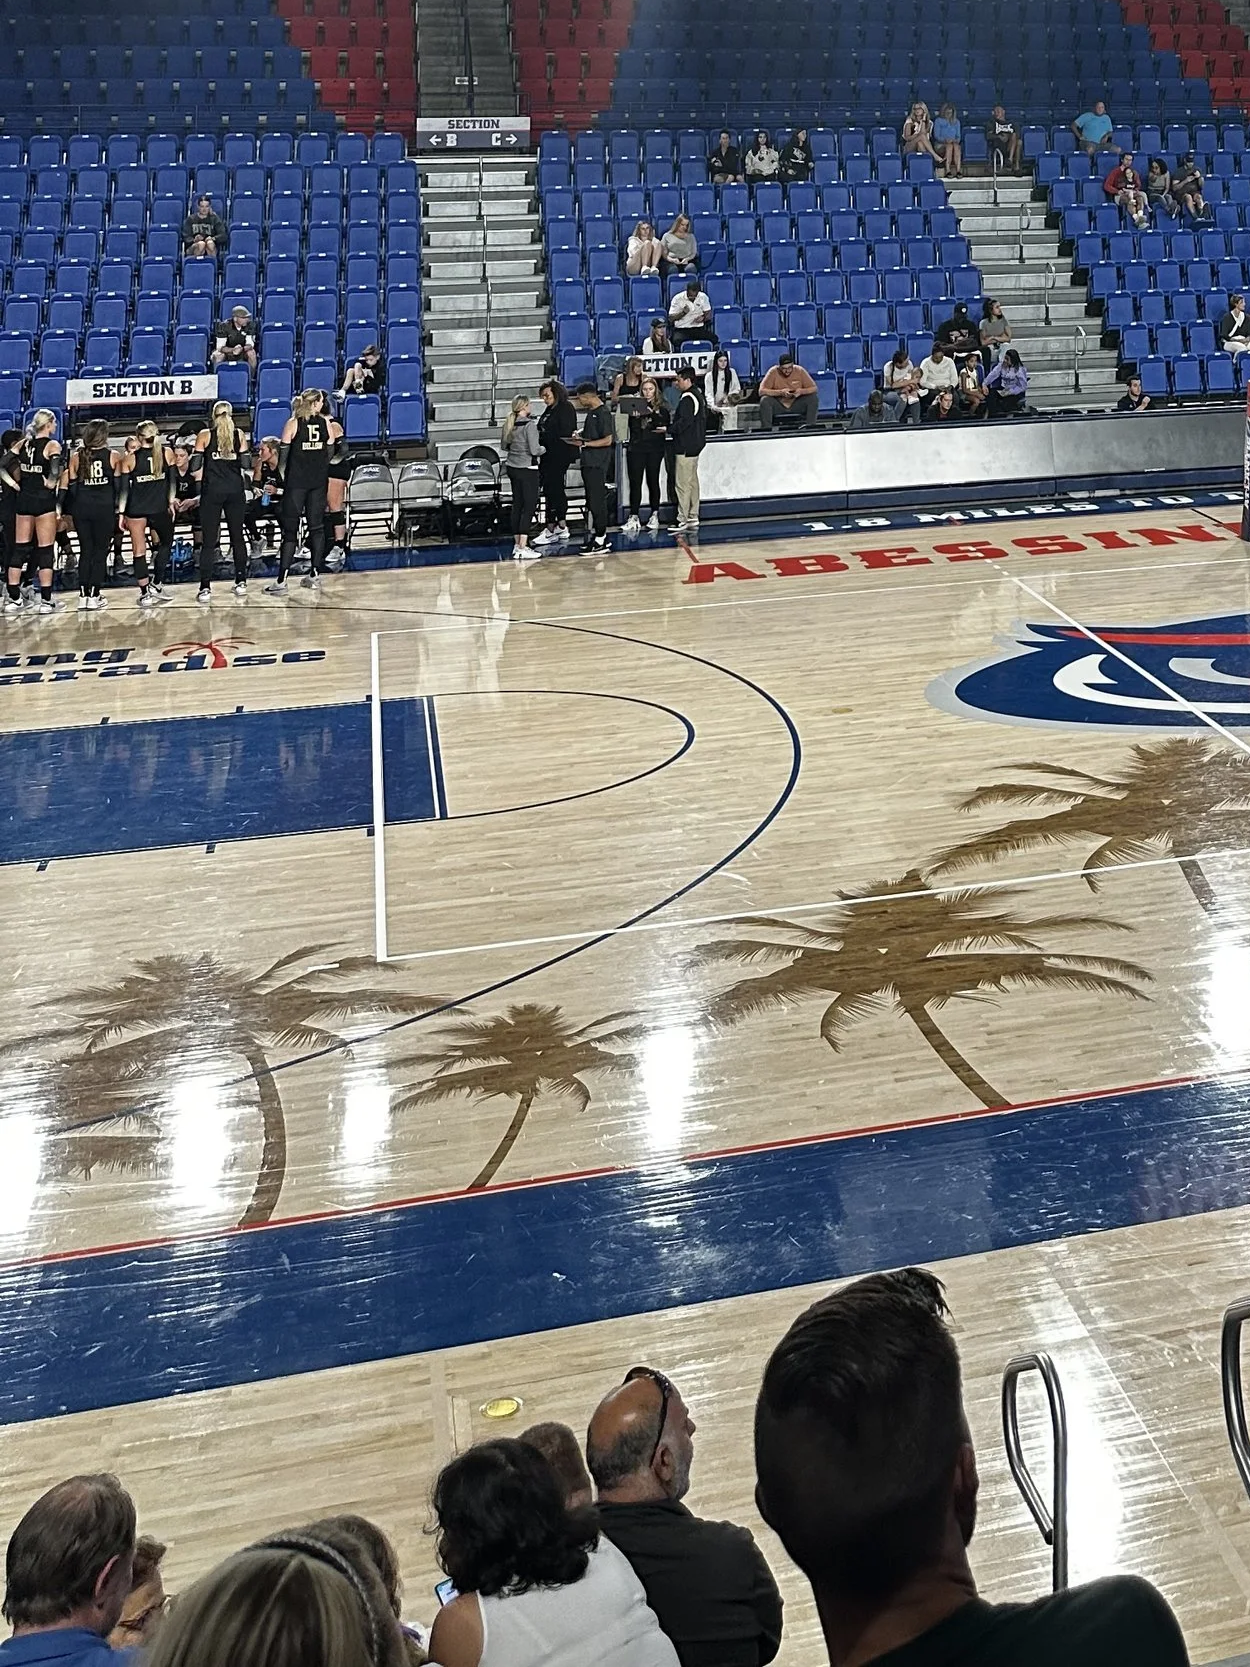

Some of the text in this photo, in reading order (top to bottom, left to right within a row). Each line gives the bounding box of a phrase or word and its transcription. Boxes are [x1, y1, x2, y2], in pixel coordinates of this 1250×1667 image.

[448, 119, 500, 129] SECTION
[446, 133, 501, 147] B C
[643, 356, 708, 372] CTION C
[92, 380, 193, 398] SECTION B
[307, 424, 320, 441] 15
[802, 516, 892, 532] 1.8
[912, 501, 1101, 524] MILES
[1116, 494, 1196, 508] TO
